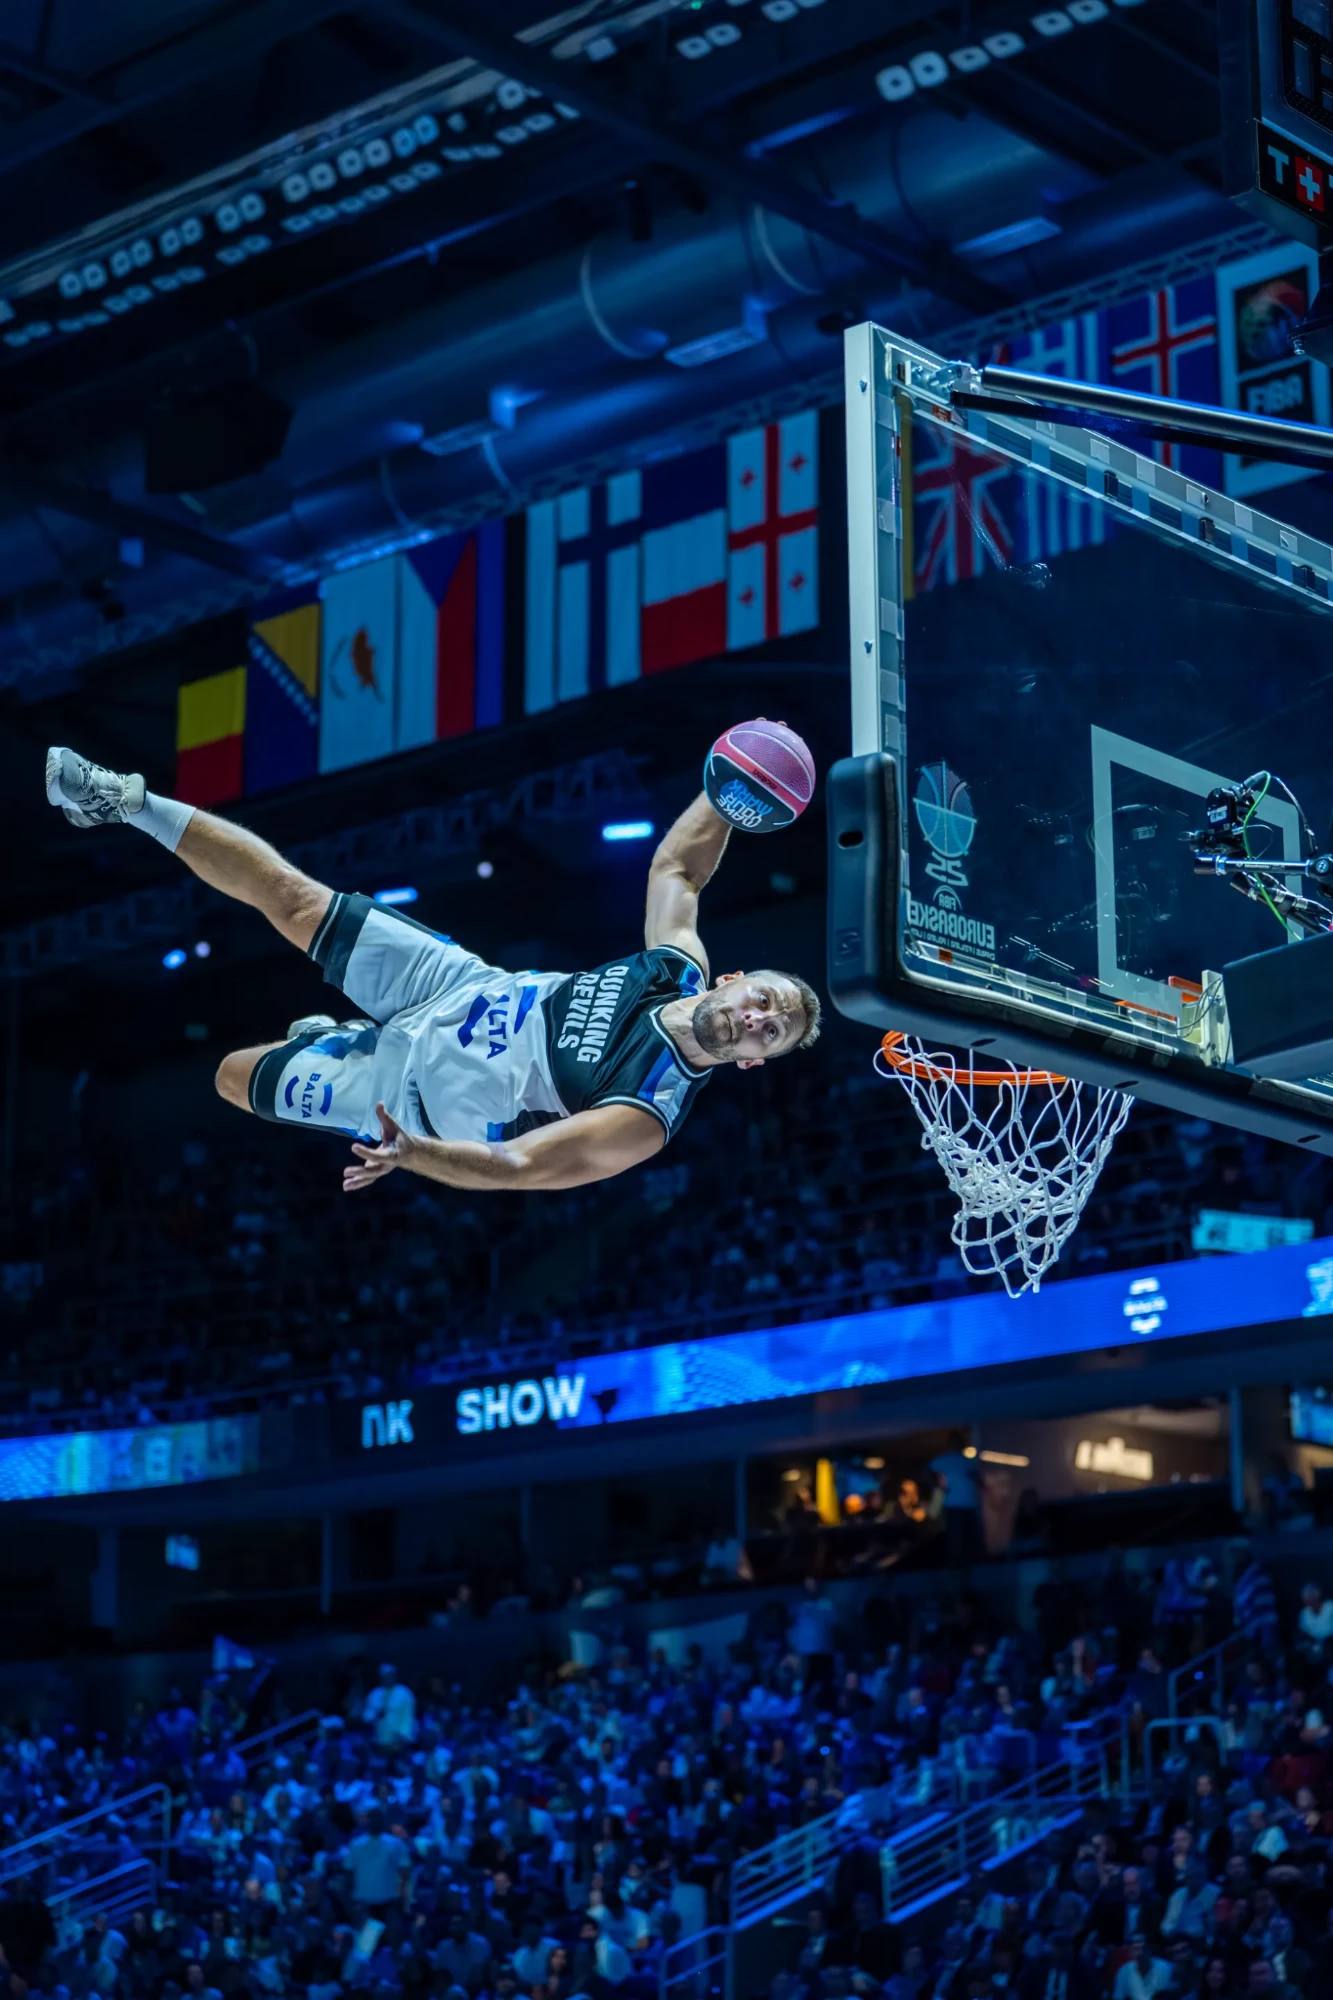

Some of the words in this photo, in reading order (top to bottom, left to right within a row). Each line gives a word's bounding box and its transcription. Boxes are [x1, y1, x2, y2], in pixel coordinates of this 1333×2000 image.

[557, 973, 601, 1049] DEVILS
[576, 965, 630, 1064] DUNKING
[301, 1072, 322, 1119] BALTA
[455, 1373, 586, 1436] SHOW
